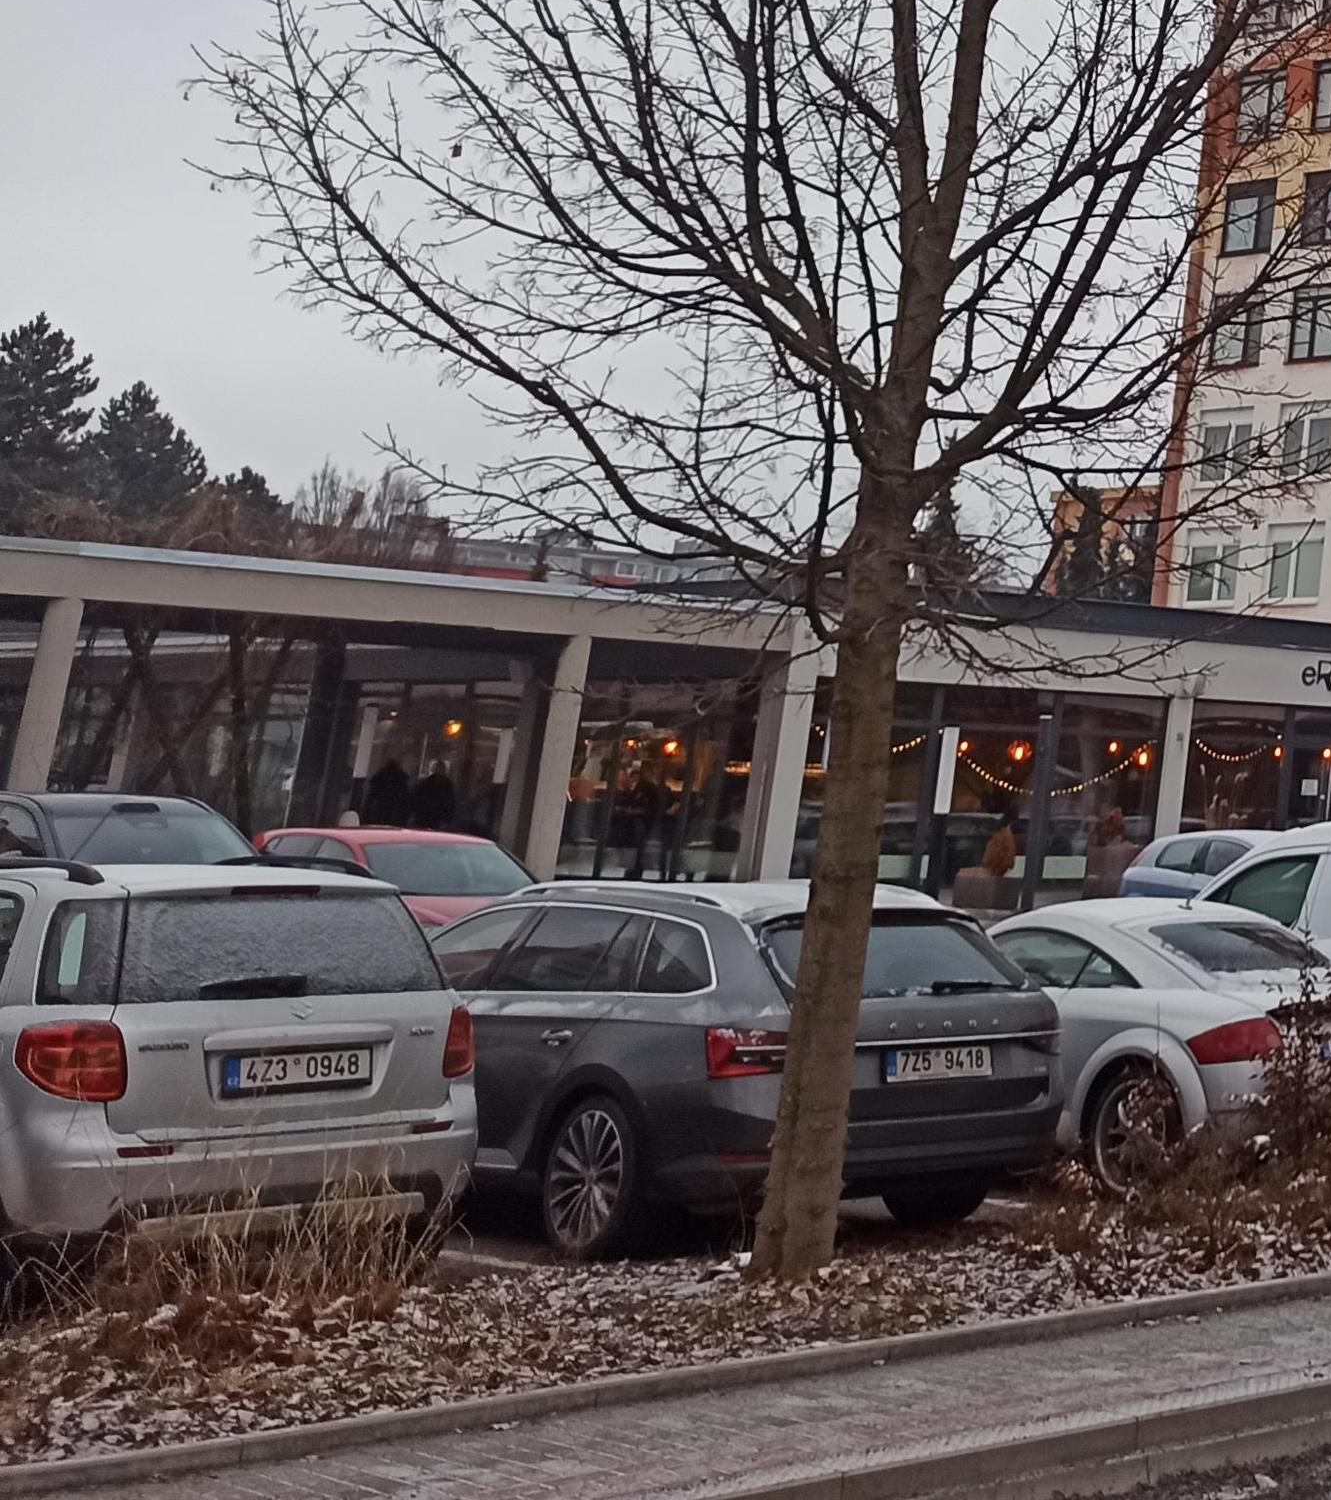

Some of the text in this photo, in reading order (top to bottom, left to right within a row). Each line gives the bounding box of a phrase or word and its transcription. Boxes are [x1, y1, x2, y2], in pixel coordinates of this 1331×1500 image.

[246, 1053, 360, 1083] 4Z3 0948
[900, 1049, 985, 1073] 7Z5 9418
